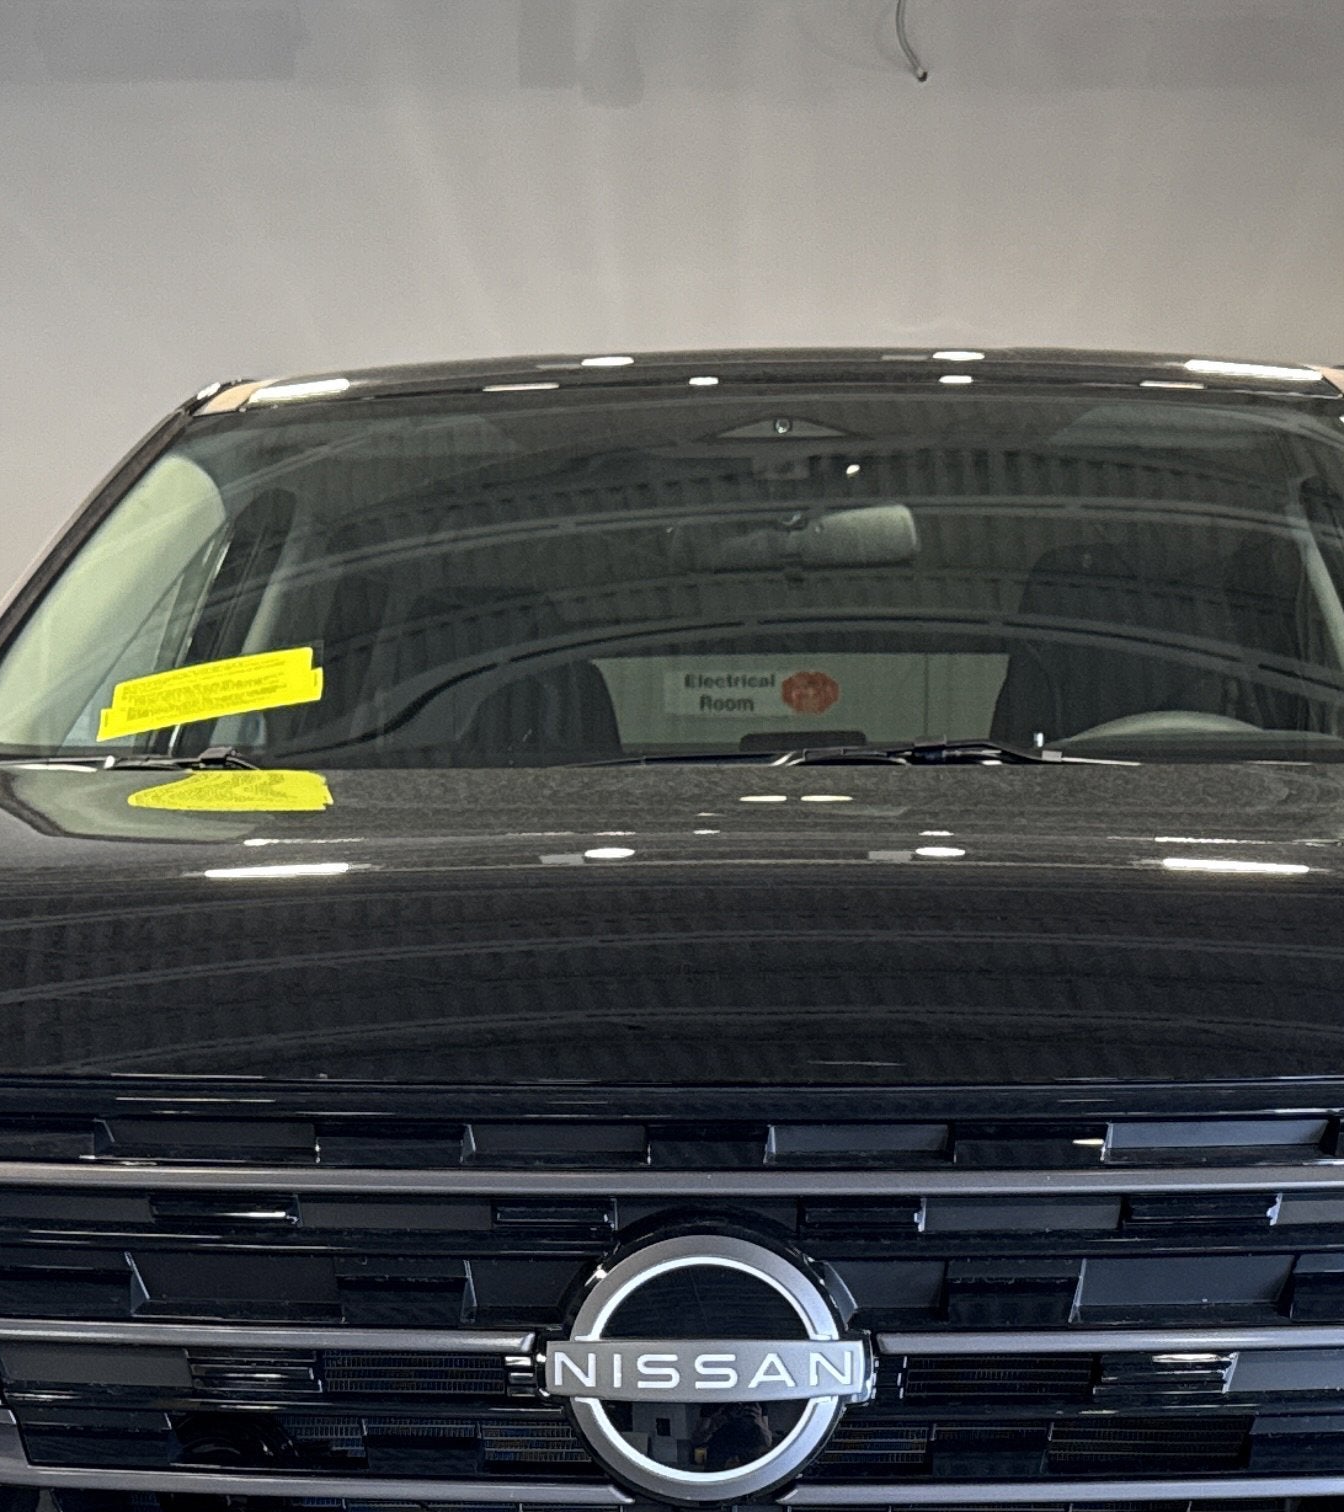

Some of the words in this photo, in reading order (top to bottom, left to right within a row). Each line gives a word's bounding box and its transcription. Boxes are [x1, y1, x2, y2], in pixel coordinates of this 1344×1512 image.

[684, 673, 775, 689] Electrical
[699, 695, 755, 712] Room
[554, 1351, 854, 1390] NISSAN
